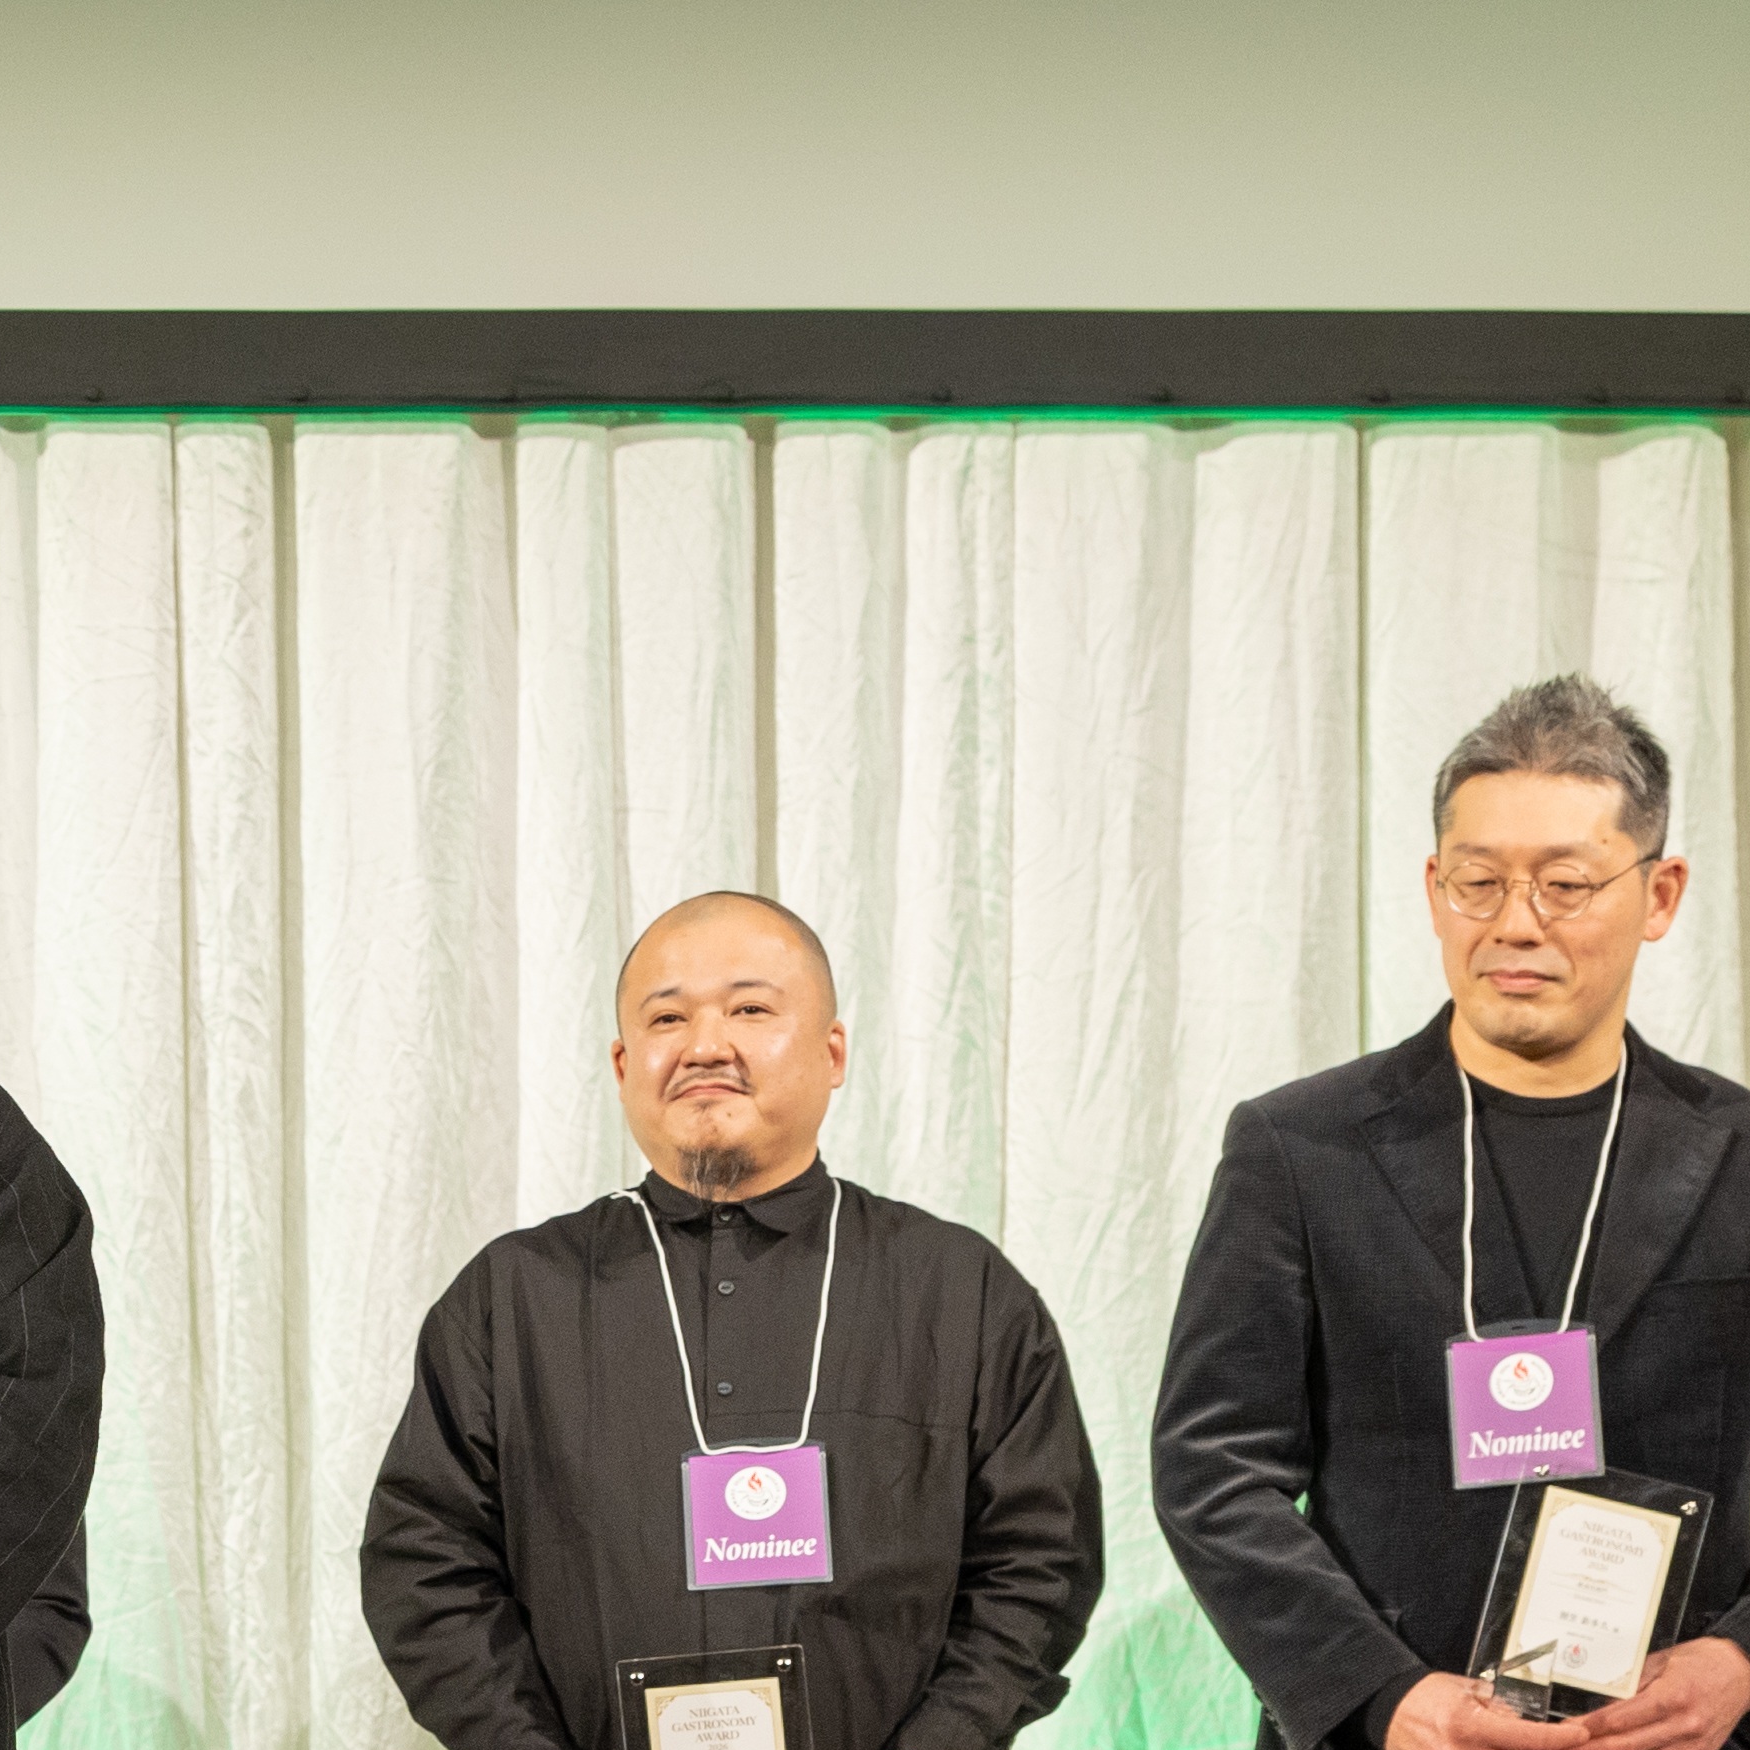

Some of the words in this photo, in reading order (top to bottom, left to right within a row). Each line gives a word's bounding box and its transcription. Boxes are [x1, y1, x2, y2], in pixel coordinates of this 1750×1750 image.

[1467, 1425, 1586, 1459] Nominee
[702, 1533, 818, 1563] Nominee
[688, 1705, 741, 1719] NIIGATA
[671, 1715, 758, 1733] GASTRONOMY
[695, 1730, 741, 1743] AWARD
